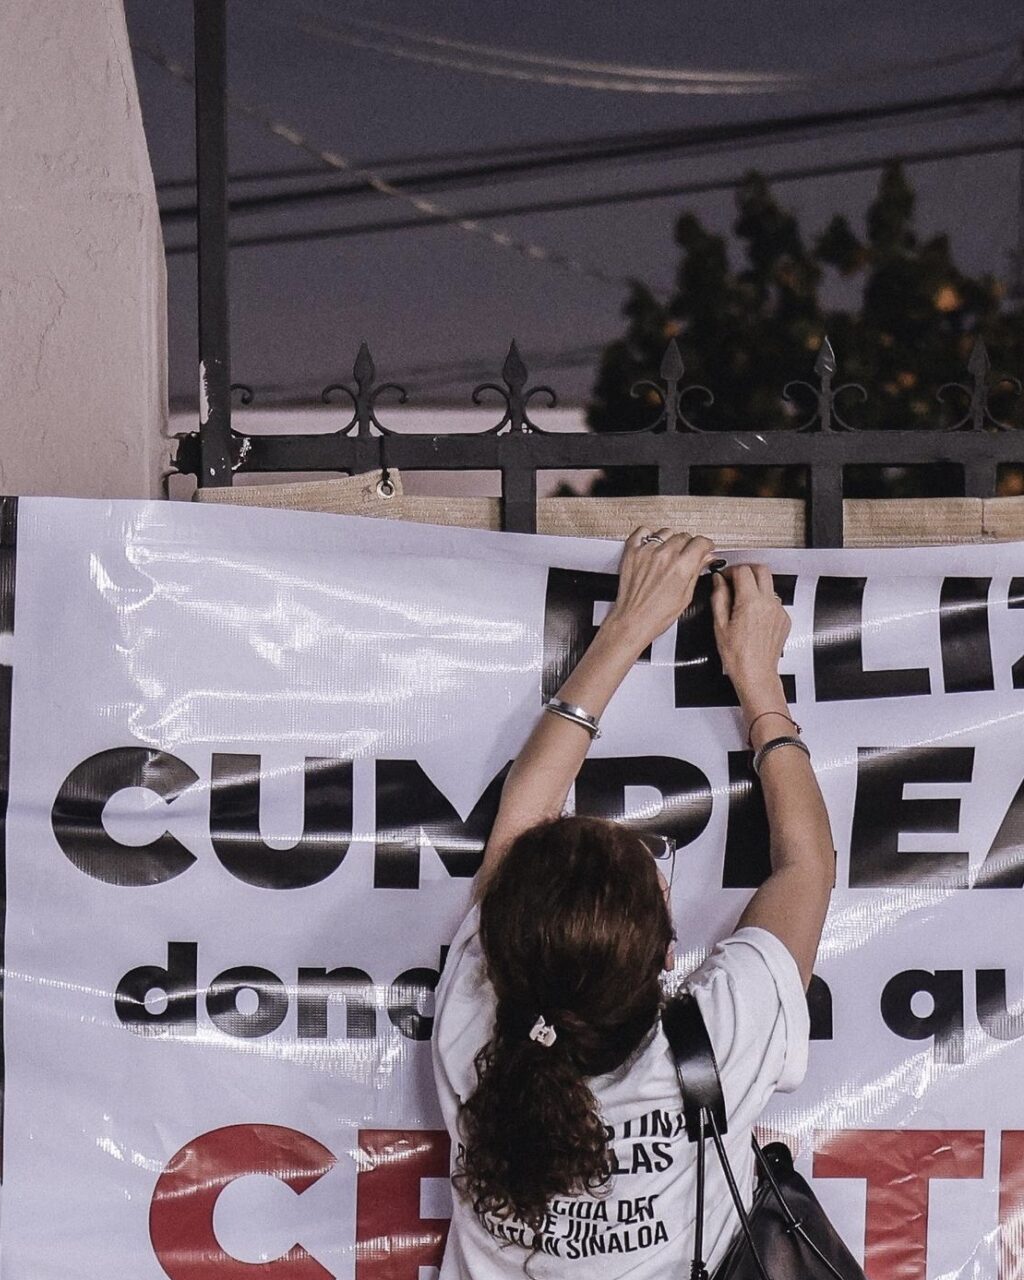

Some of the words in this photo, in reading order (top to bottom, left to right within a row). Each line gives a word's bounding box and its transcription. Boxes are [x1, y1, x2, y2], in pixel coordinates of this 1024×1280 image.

[542, 567, 1024, 708] FELI
[880, 969, 1024, 1064] qu
[607, 1142, 674, 1175] LAS
[566, 1220, 669, 1259] SINALOA
